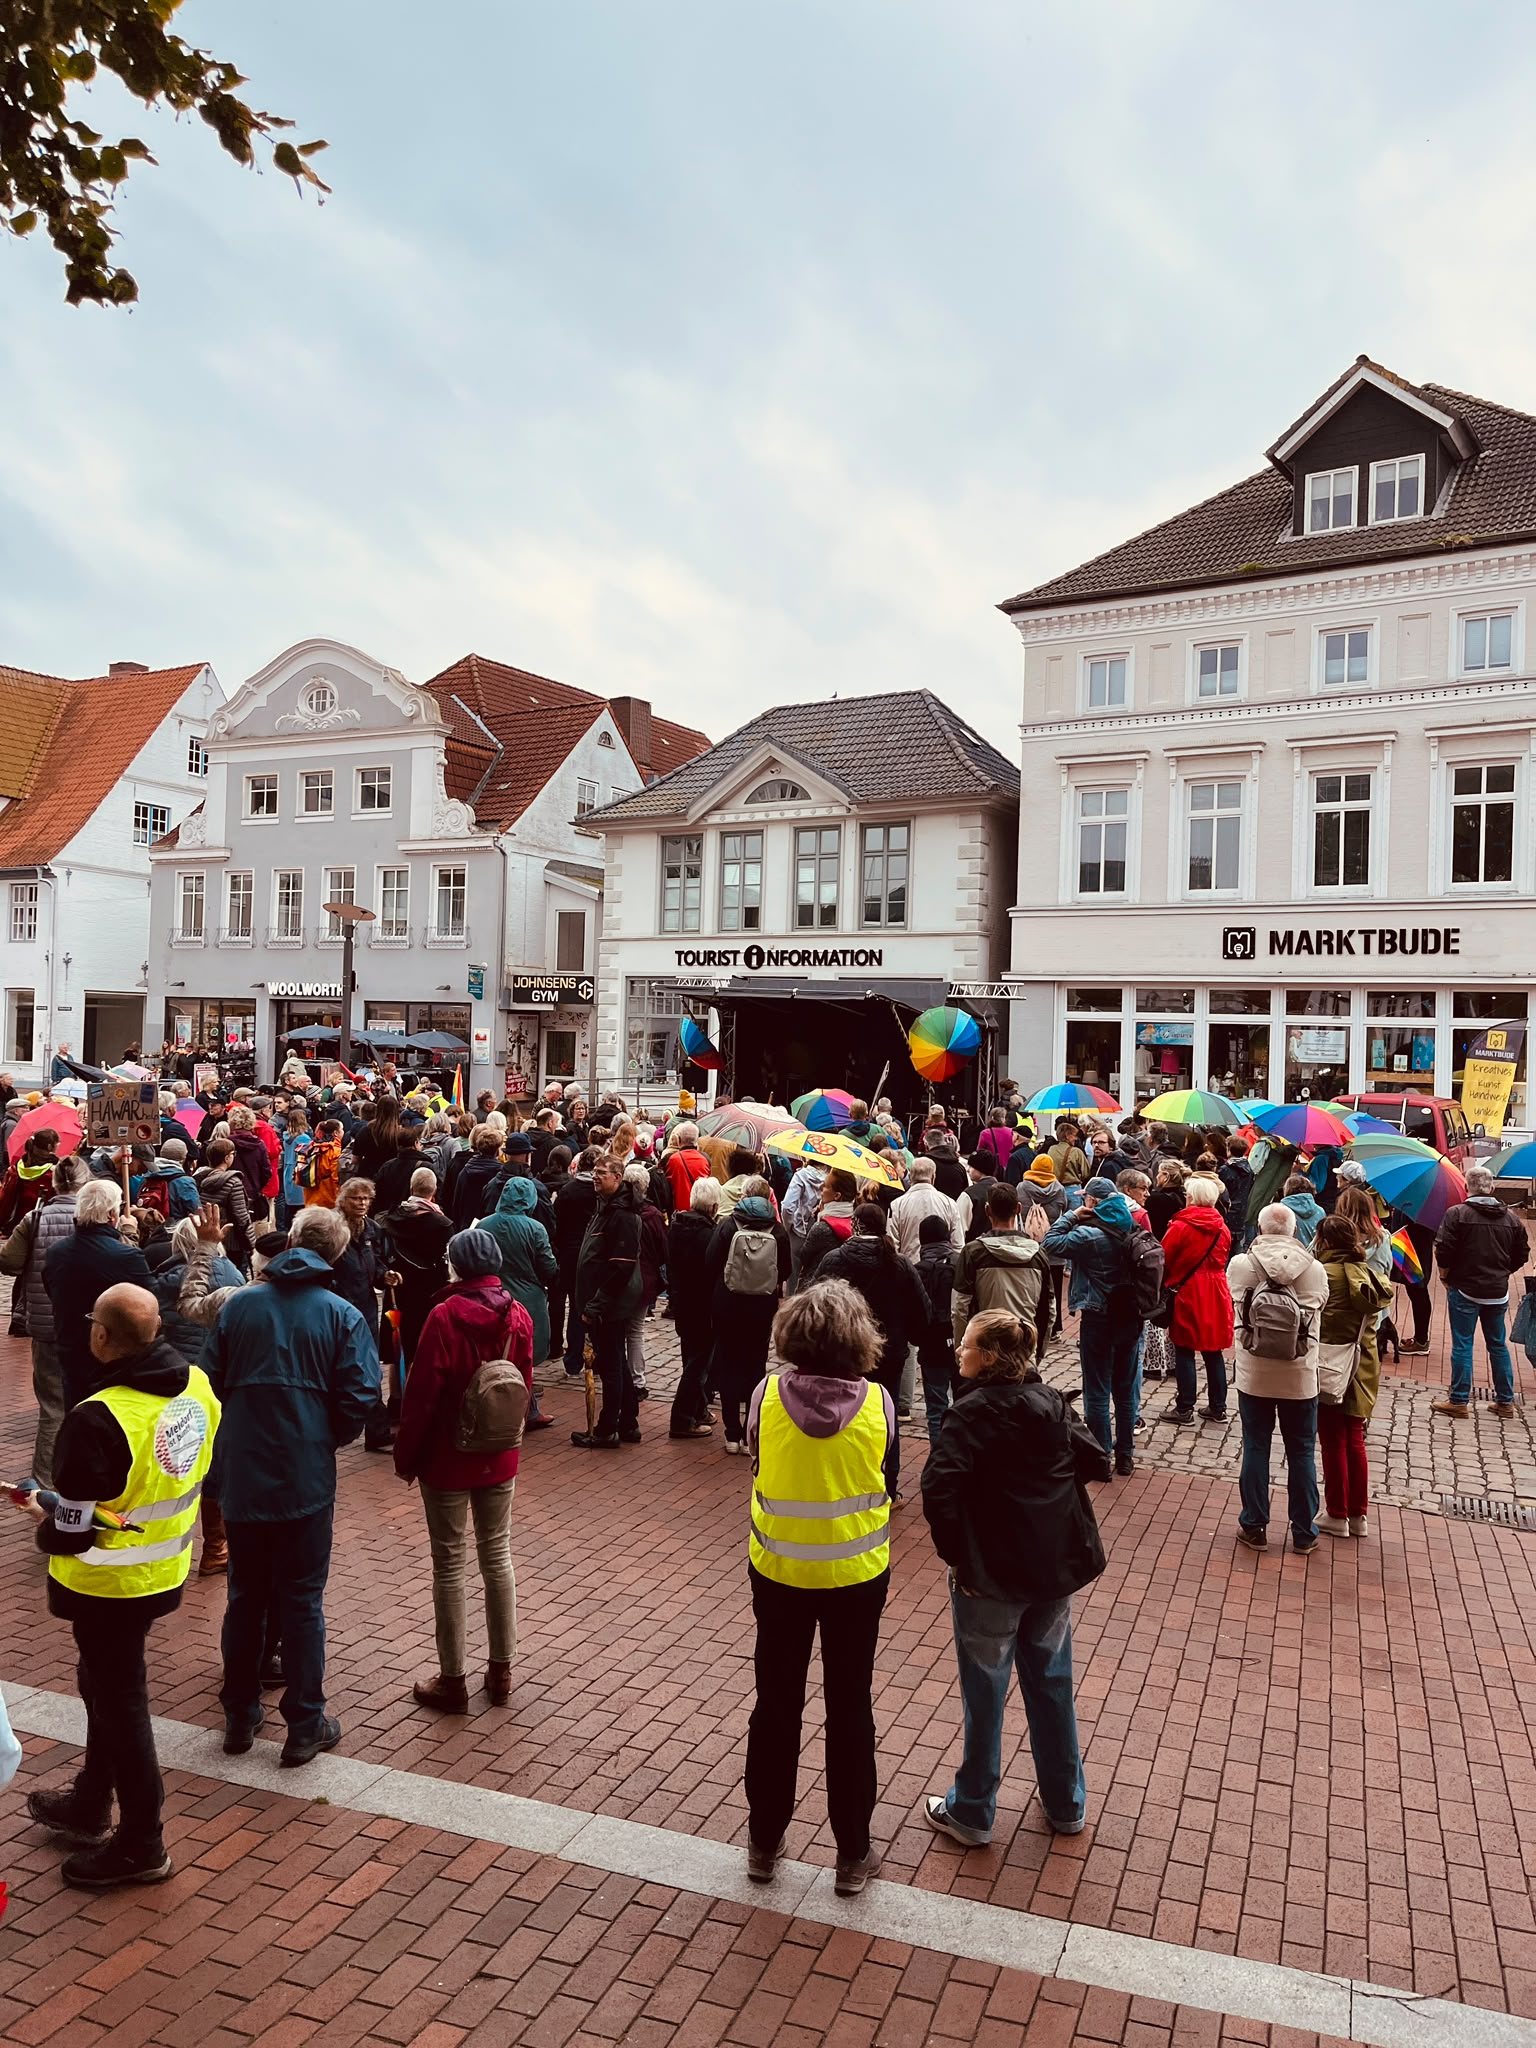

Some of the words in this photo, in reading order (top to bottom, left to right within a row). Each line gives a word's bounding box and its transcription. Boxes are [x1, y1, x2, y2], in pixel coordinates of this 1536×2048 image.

[1269, 928, 1460, 955] MARKTBUDE
[675, 950, 741, 967] TOURIST
[267, 981, 344, 997] WOOLWORTH
[514, 976, 577, 989] JOHNSENS
[531, 990, 559, 1002] GYM
[1474, 1049, 1515, 1060] MARKTBUDE
[1472, 1063, 1513, 1077] Kreatives
[1477, 1079, 1502, 1090] Kunst
[1469, 1089, 1508, 1103] Handwerk
[165, 1408, 193, 1438] Meldorf
